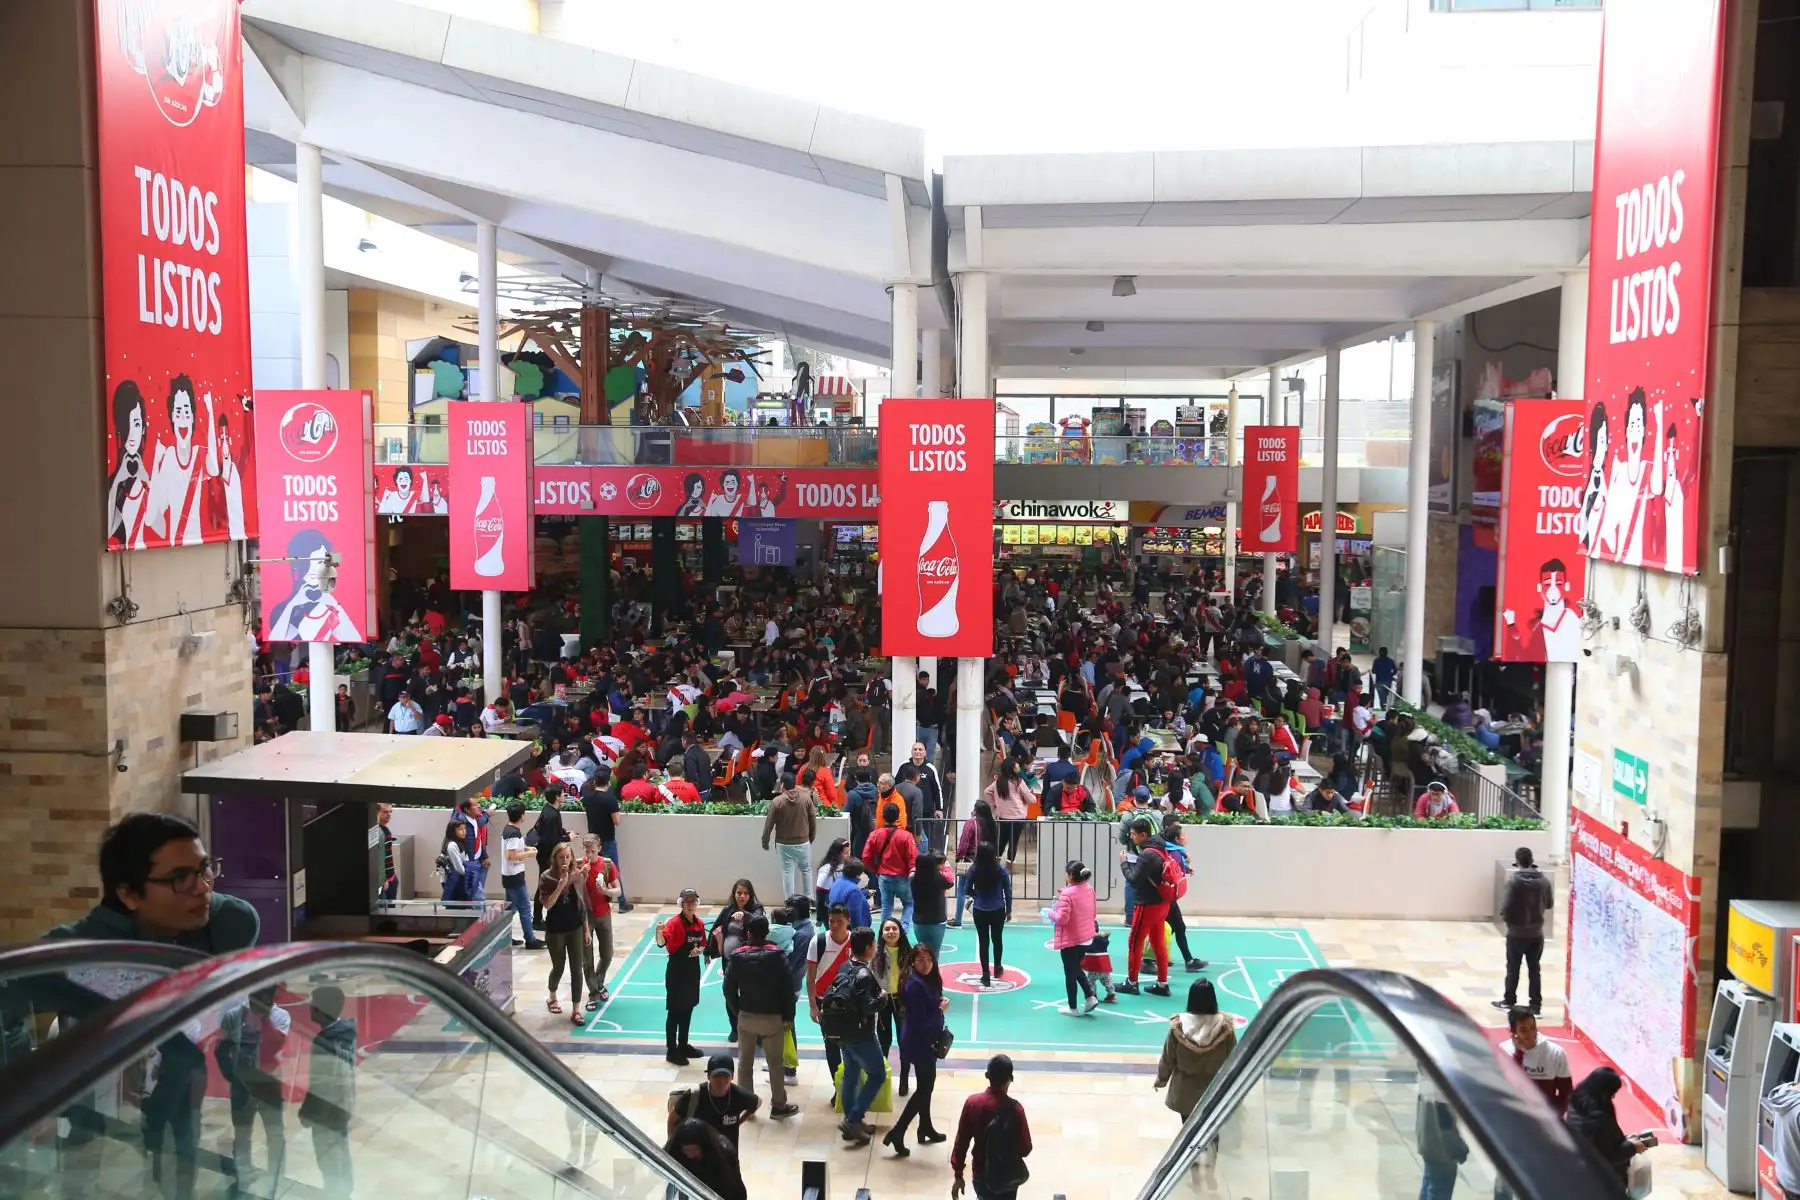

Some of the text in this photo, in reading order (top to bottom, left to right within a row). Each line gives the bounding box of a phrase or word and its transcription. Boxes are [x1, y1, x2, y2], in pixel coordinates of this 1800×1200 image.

[135, 165, 220, 256] TODOS
[1615, 169, 1686, 260] TODOS
[138, 254, 223, 336] LISTOS
[1609, 261, 1682, 344] LISTOS
[467, 420, 506, 436] TODOS
[909, 424, 966, 446] TODOS
[467, 440, 508, 456] LISTOS
[1258, 438, 1286, 449] TODOS
[909, 450, 967, 472] LISTOS
[1257, 451, 1286, 462] LISTOS
[283, 475, 337, 497] TODOS
[535, 481, 592, 505] ISTOS
[796, 483, 857, 507] TODOS
[1538, 486, 1583, 508] TODO
[283, 500, 339, 522] LISTOS
[1011, 500, 1100, 518] chinawok
[1536, 512, 1583, 535] LISTO
